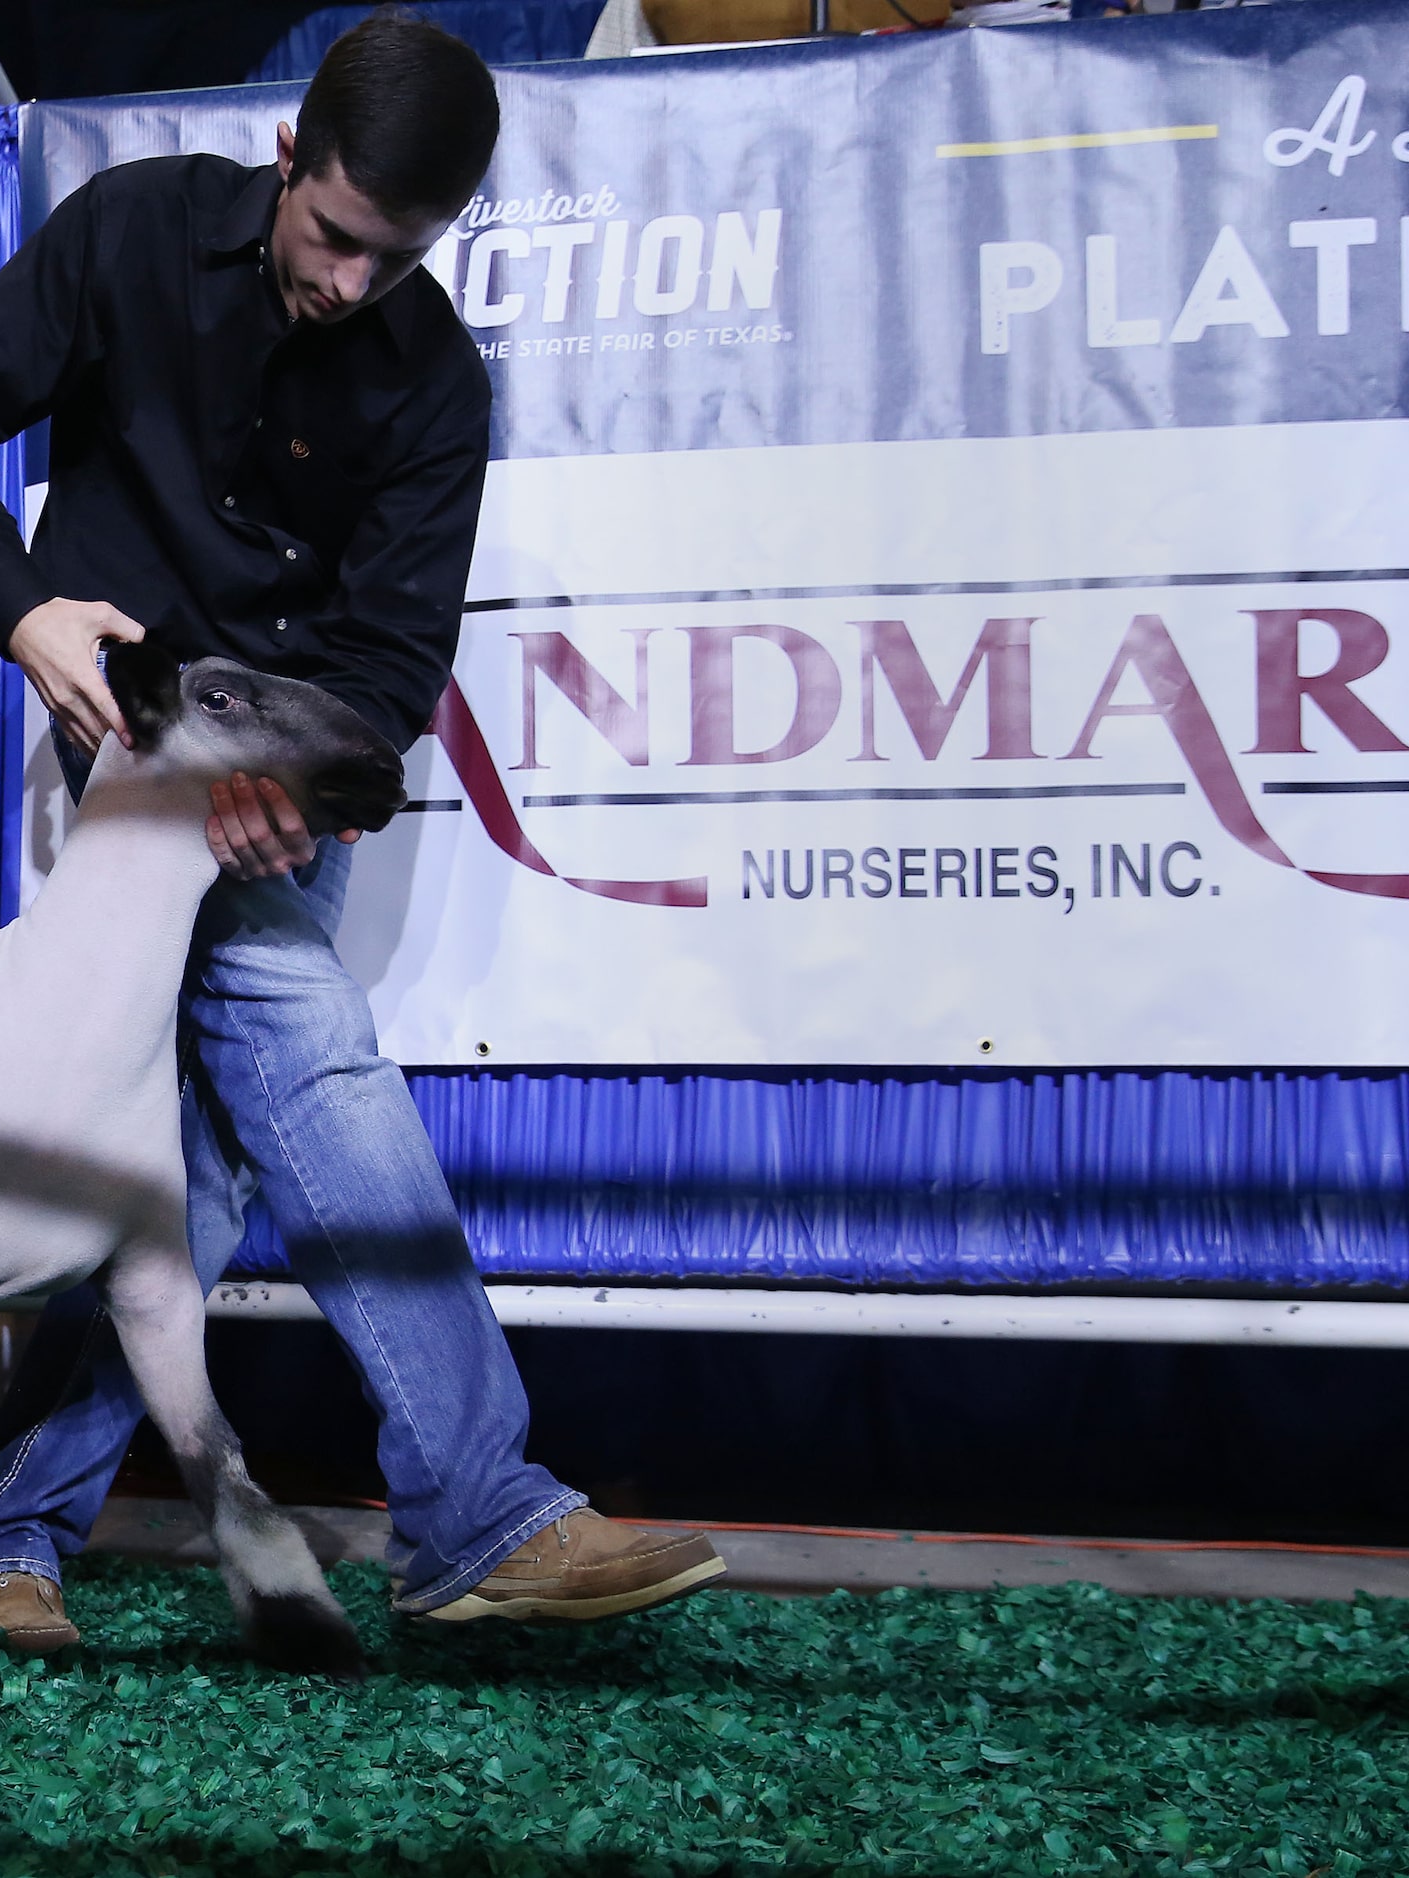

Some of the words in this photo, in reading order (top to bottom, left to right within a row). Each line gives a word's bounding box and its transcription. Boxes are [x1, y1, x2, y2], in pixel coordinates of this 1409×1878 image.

[1263, 75, 1377, 177] A
[518, 336, 592, 358] STATE
[600, 332, 655, 353] FAIR
[663, 328, 698, 349] OF
[743, 846, 1075, 915] NURSERIES,
[1091, 841, 1221, 898] INC.
